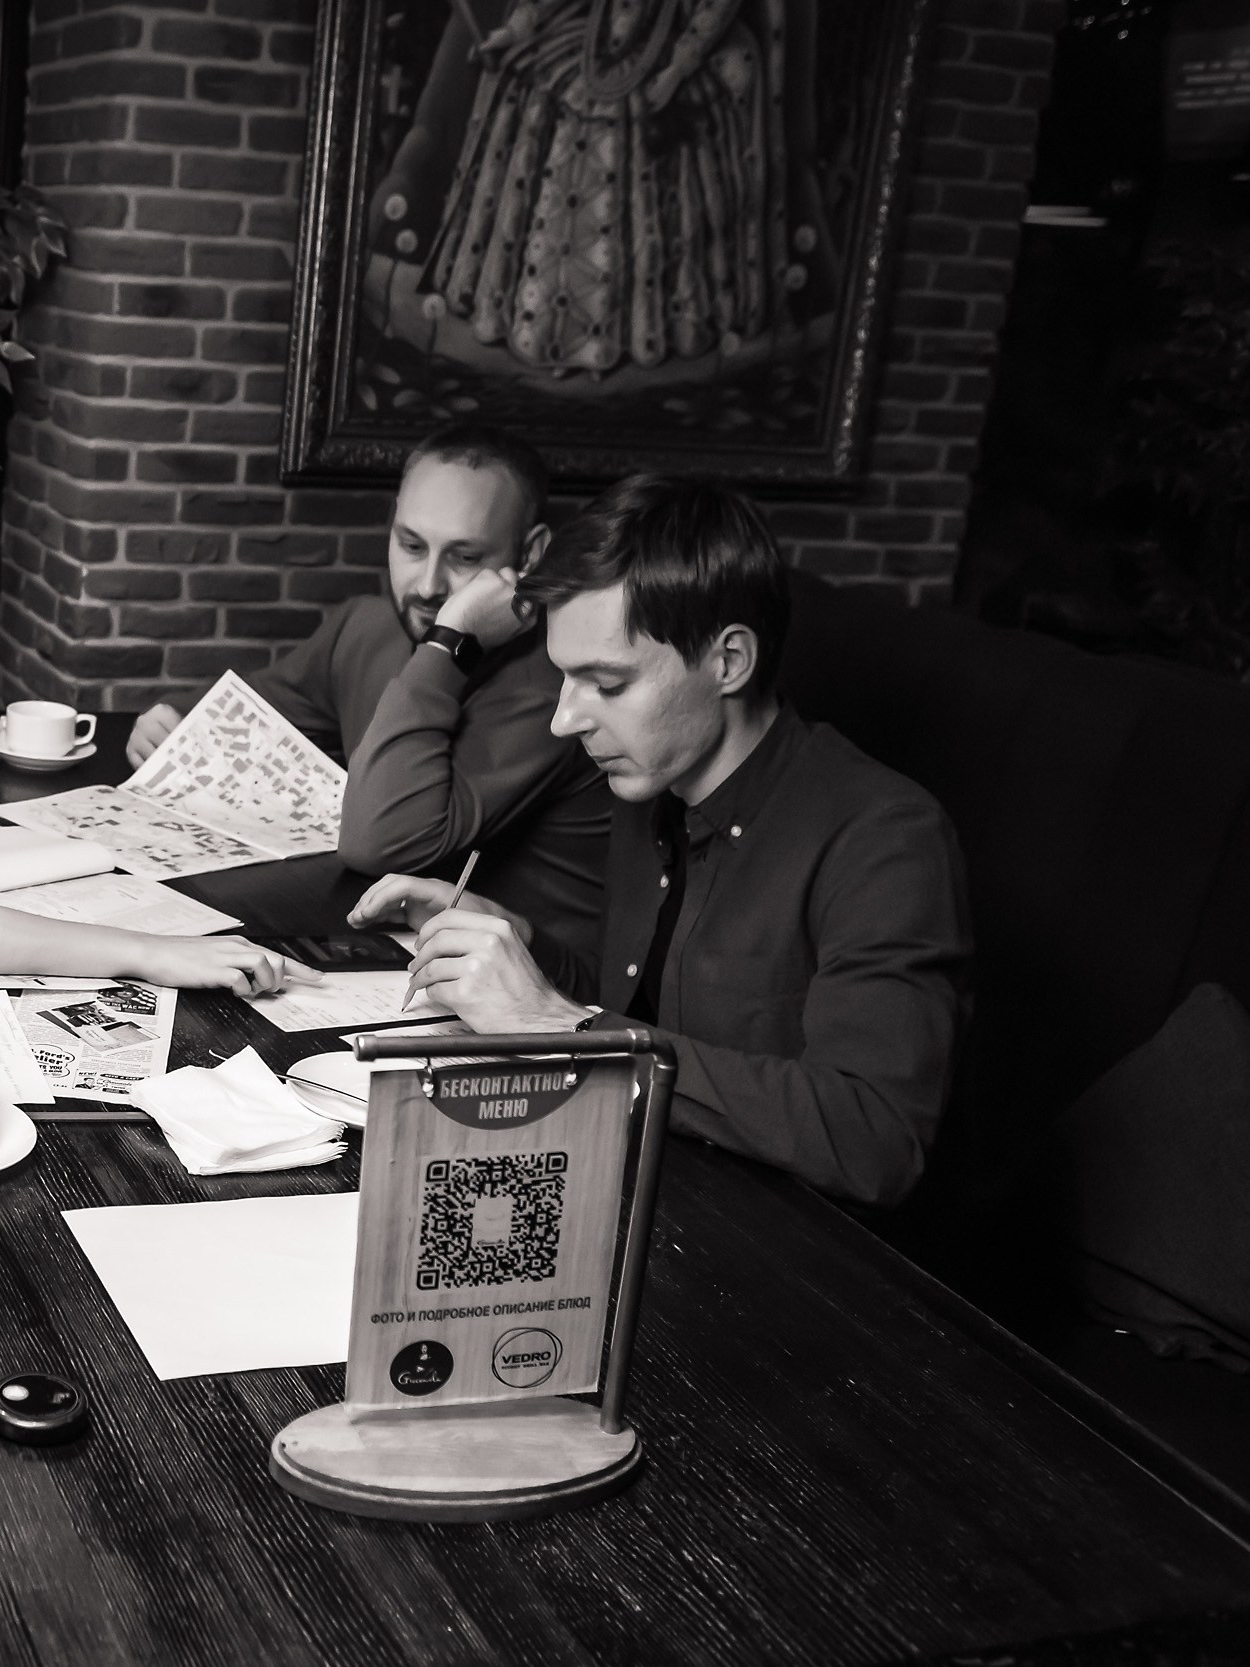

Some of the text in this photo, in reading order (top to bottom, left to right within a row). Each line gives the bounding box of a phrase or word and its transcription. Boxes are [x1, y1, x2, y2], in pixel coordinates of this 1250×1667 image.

[40, 1050, 70, 1061] Ford's
[478, 1098, 529, 1120] МЕНЮ
[370, 1296, 591, 1324] ФОТО И ПОДРОБНОЕ ОПИСАНИЕ БЛЮД
[502, 1351, 551, 1364] VEDRO
